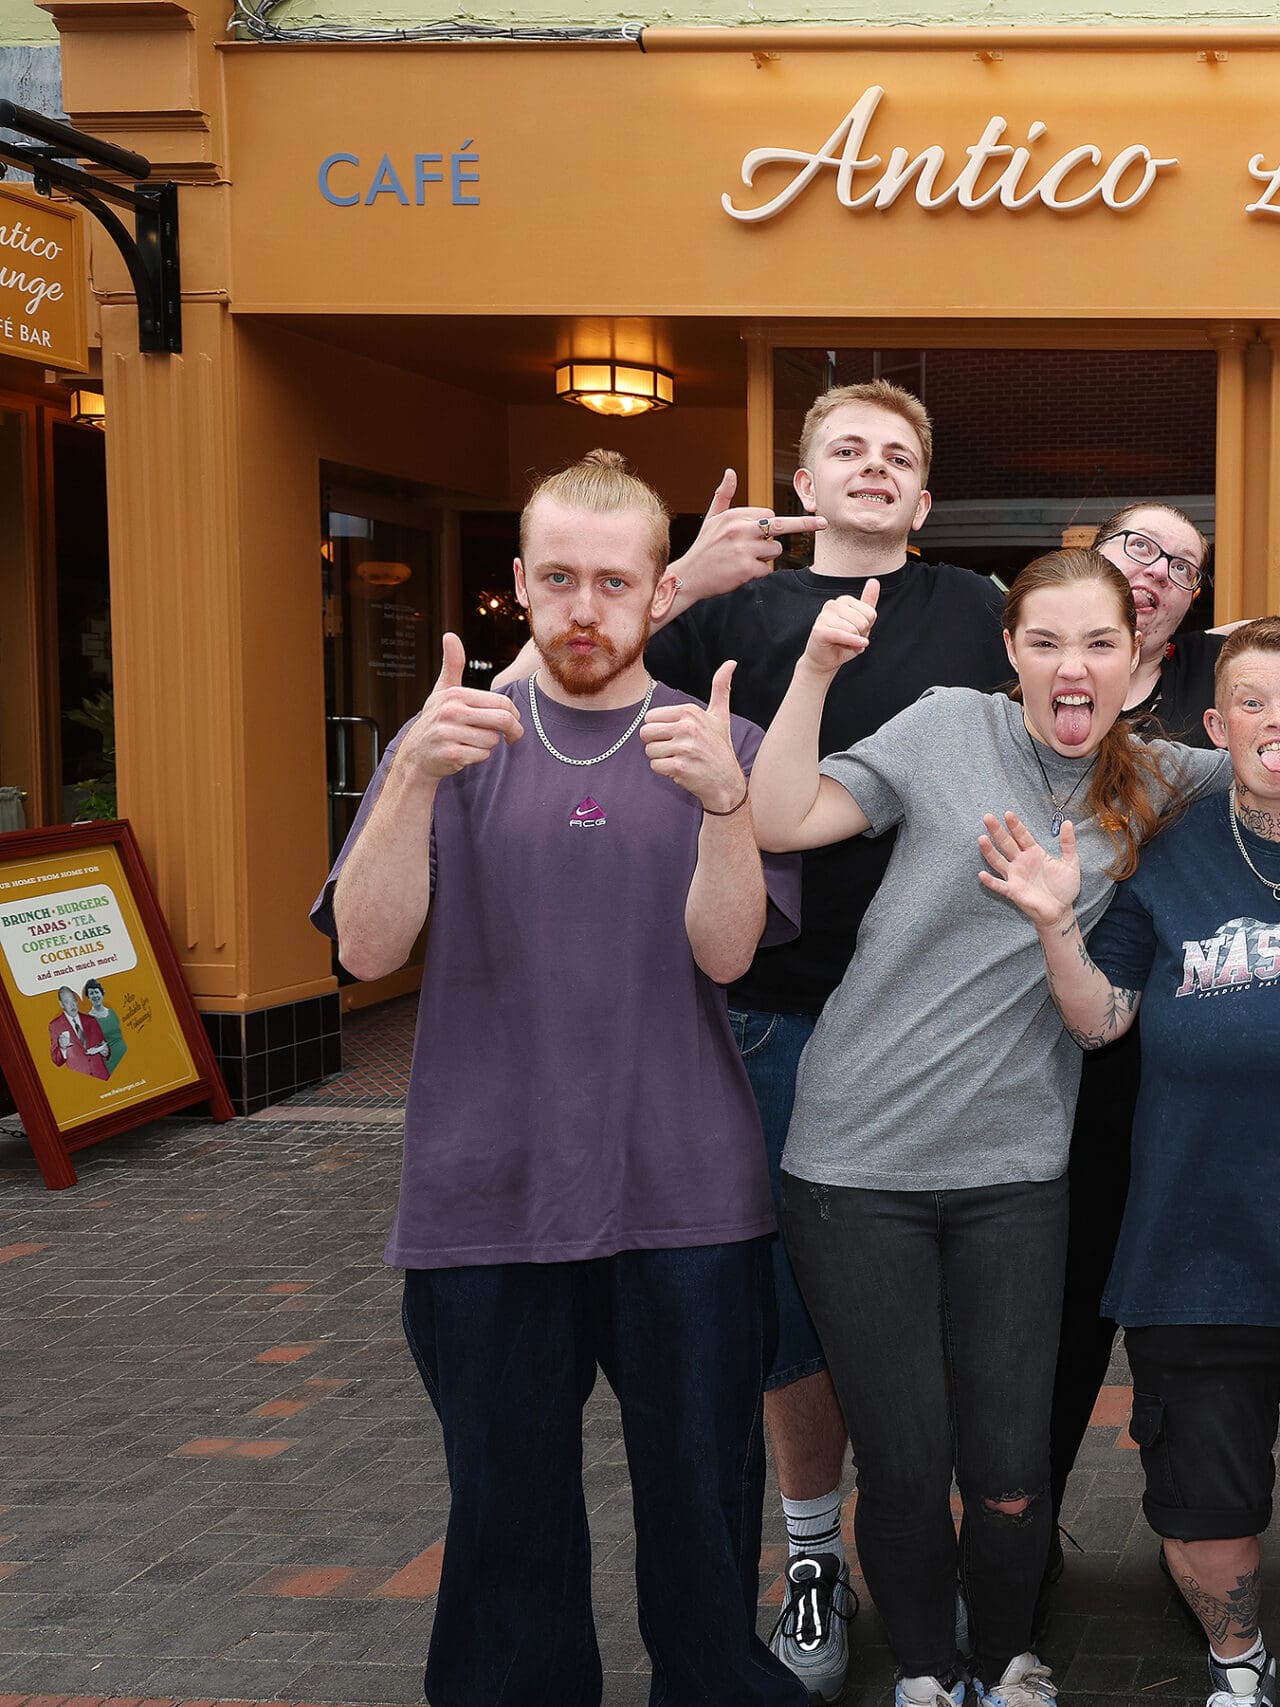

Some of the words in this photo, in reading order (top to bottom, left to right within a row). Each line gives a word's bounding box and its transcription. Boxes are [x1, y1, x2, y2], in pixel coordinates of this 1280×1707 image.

[720, 84, 1181, 224] Antico
[317, 138, 481, 207] CAFÉ
[20, 323, 53, 348] BAR
[569, 817, 607, 828] ACG
[12, 877, 37, 887] HOME
[37, 873, 60, 882] FROM
[60, 868, 84, 878] HOME
[84, 865, 100, 874] FOR
[1, 908, 52, 927] BRUNCH
[55, 896, 110, 915] BURGERS
[27, 919, 67, 936] TAPAS
[72, 913, 97, 927] TEA
[22, 934, 69, 953] COFFEE
[74, 924, 112, 941] CAKES
[40, 941, 105, 964] COCKTAILS
[37, 970, 52, 981] and
[53, 965, 75, 976] much
[75, 960, 96, 971] much
[97, 954, 118, 965] more!
[1197, 984, 1251, 999] TRADING
